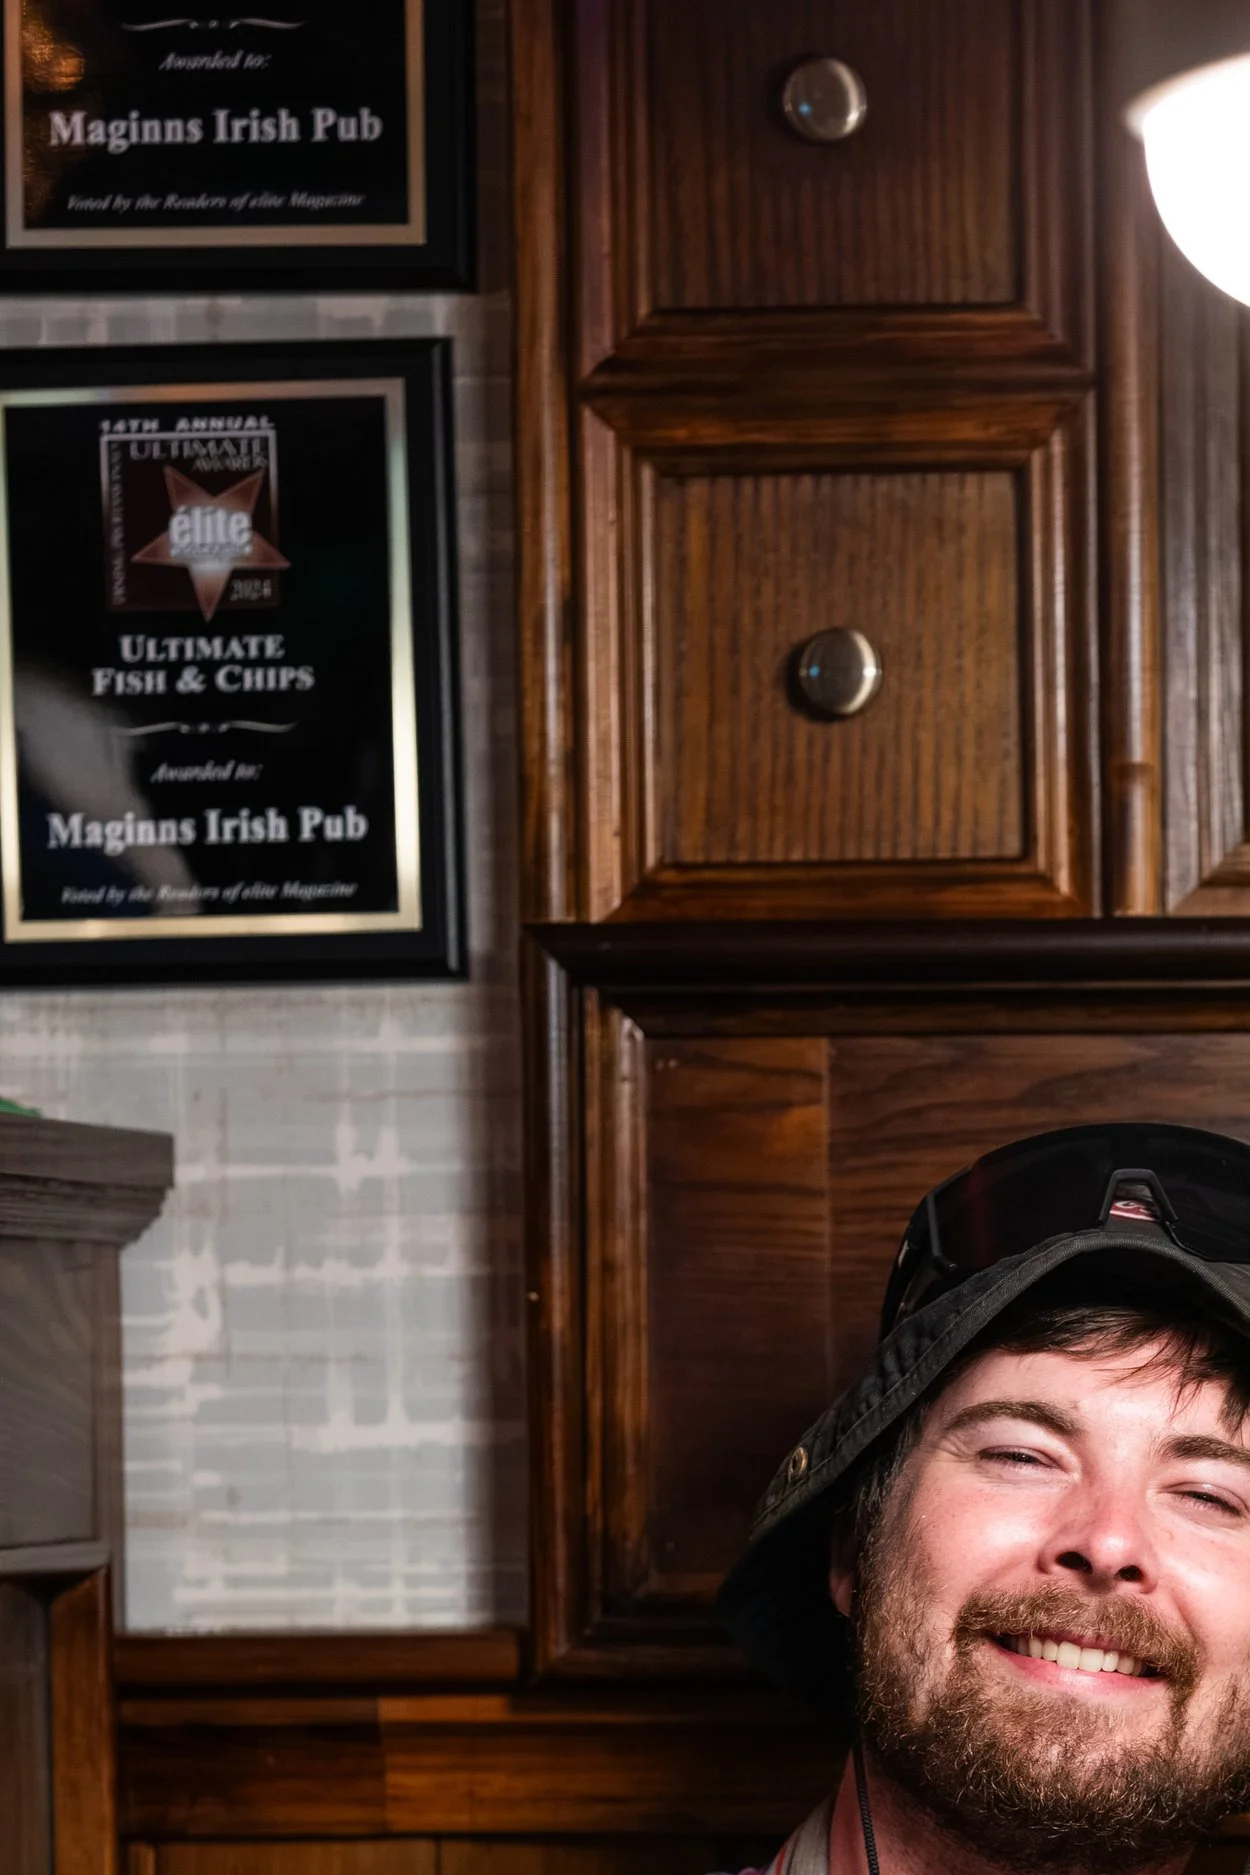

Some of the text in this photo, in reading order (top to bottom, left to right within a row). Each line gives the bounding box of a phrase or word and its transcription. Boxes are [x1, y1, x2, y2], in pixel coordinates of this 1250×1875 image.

[158, 49, 272, 71] Awarded to:
[49, 107, 383, 154] Maginns Irish Pub
[67, 194, 113, 210] Voted
[112, 193, 134, 214] by
[134, 193, 162, 210] the
[163, 191, 227, 210] Readers
[229, 192, 251, 212] of
[289, 191, 366, 212] Magazine
[100, 415, 275, 433] 14TH ANNUAL
[129, 438, 264, 460] ULTIMATE
[119, 634, 285, 663] ULTIMATE
[92, 664, 315, 696] FISH & CHIPS
[150, 759, 264, 783] Awarded to:
[47, 806, 368, 856] Maginns Irish Pub
[61, 885, 107, 904] Voted
[106, 885, 127, 907] by
[128, 885, 155, 903] the
[157, 883, 220, 902] Readers
[221, 881, 245, 904] of
[280, 880, 358, 902] Magazine
